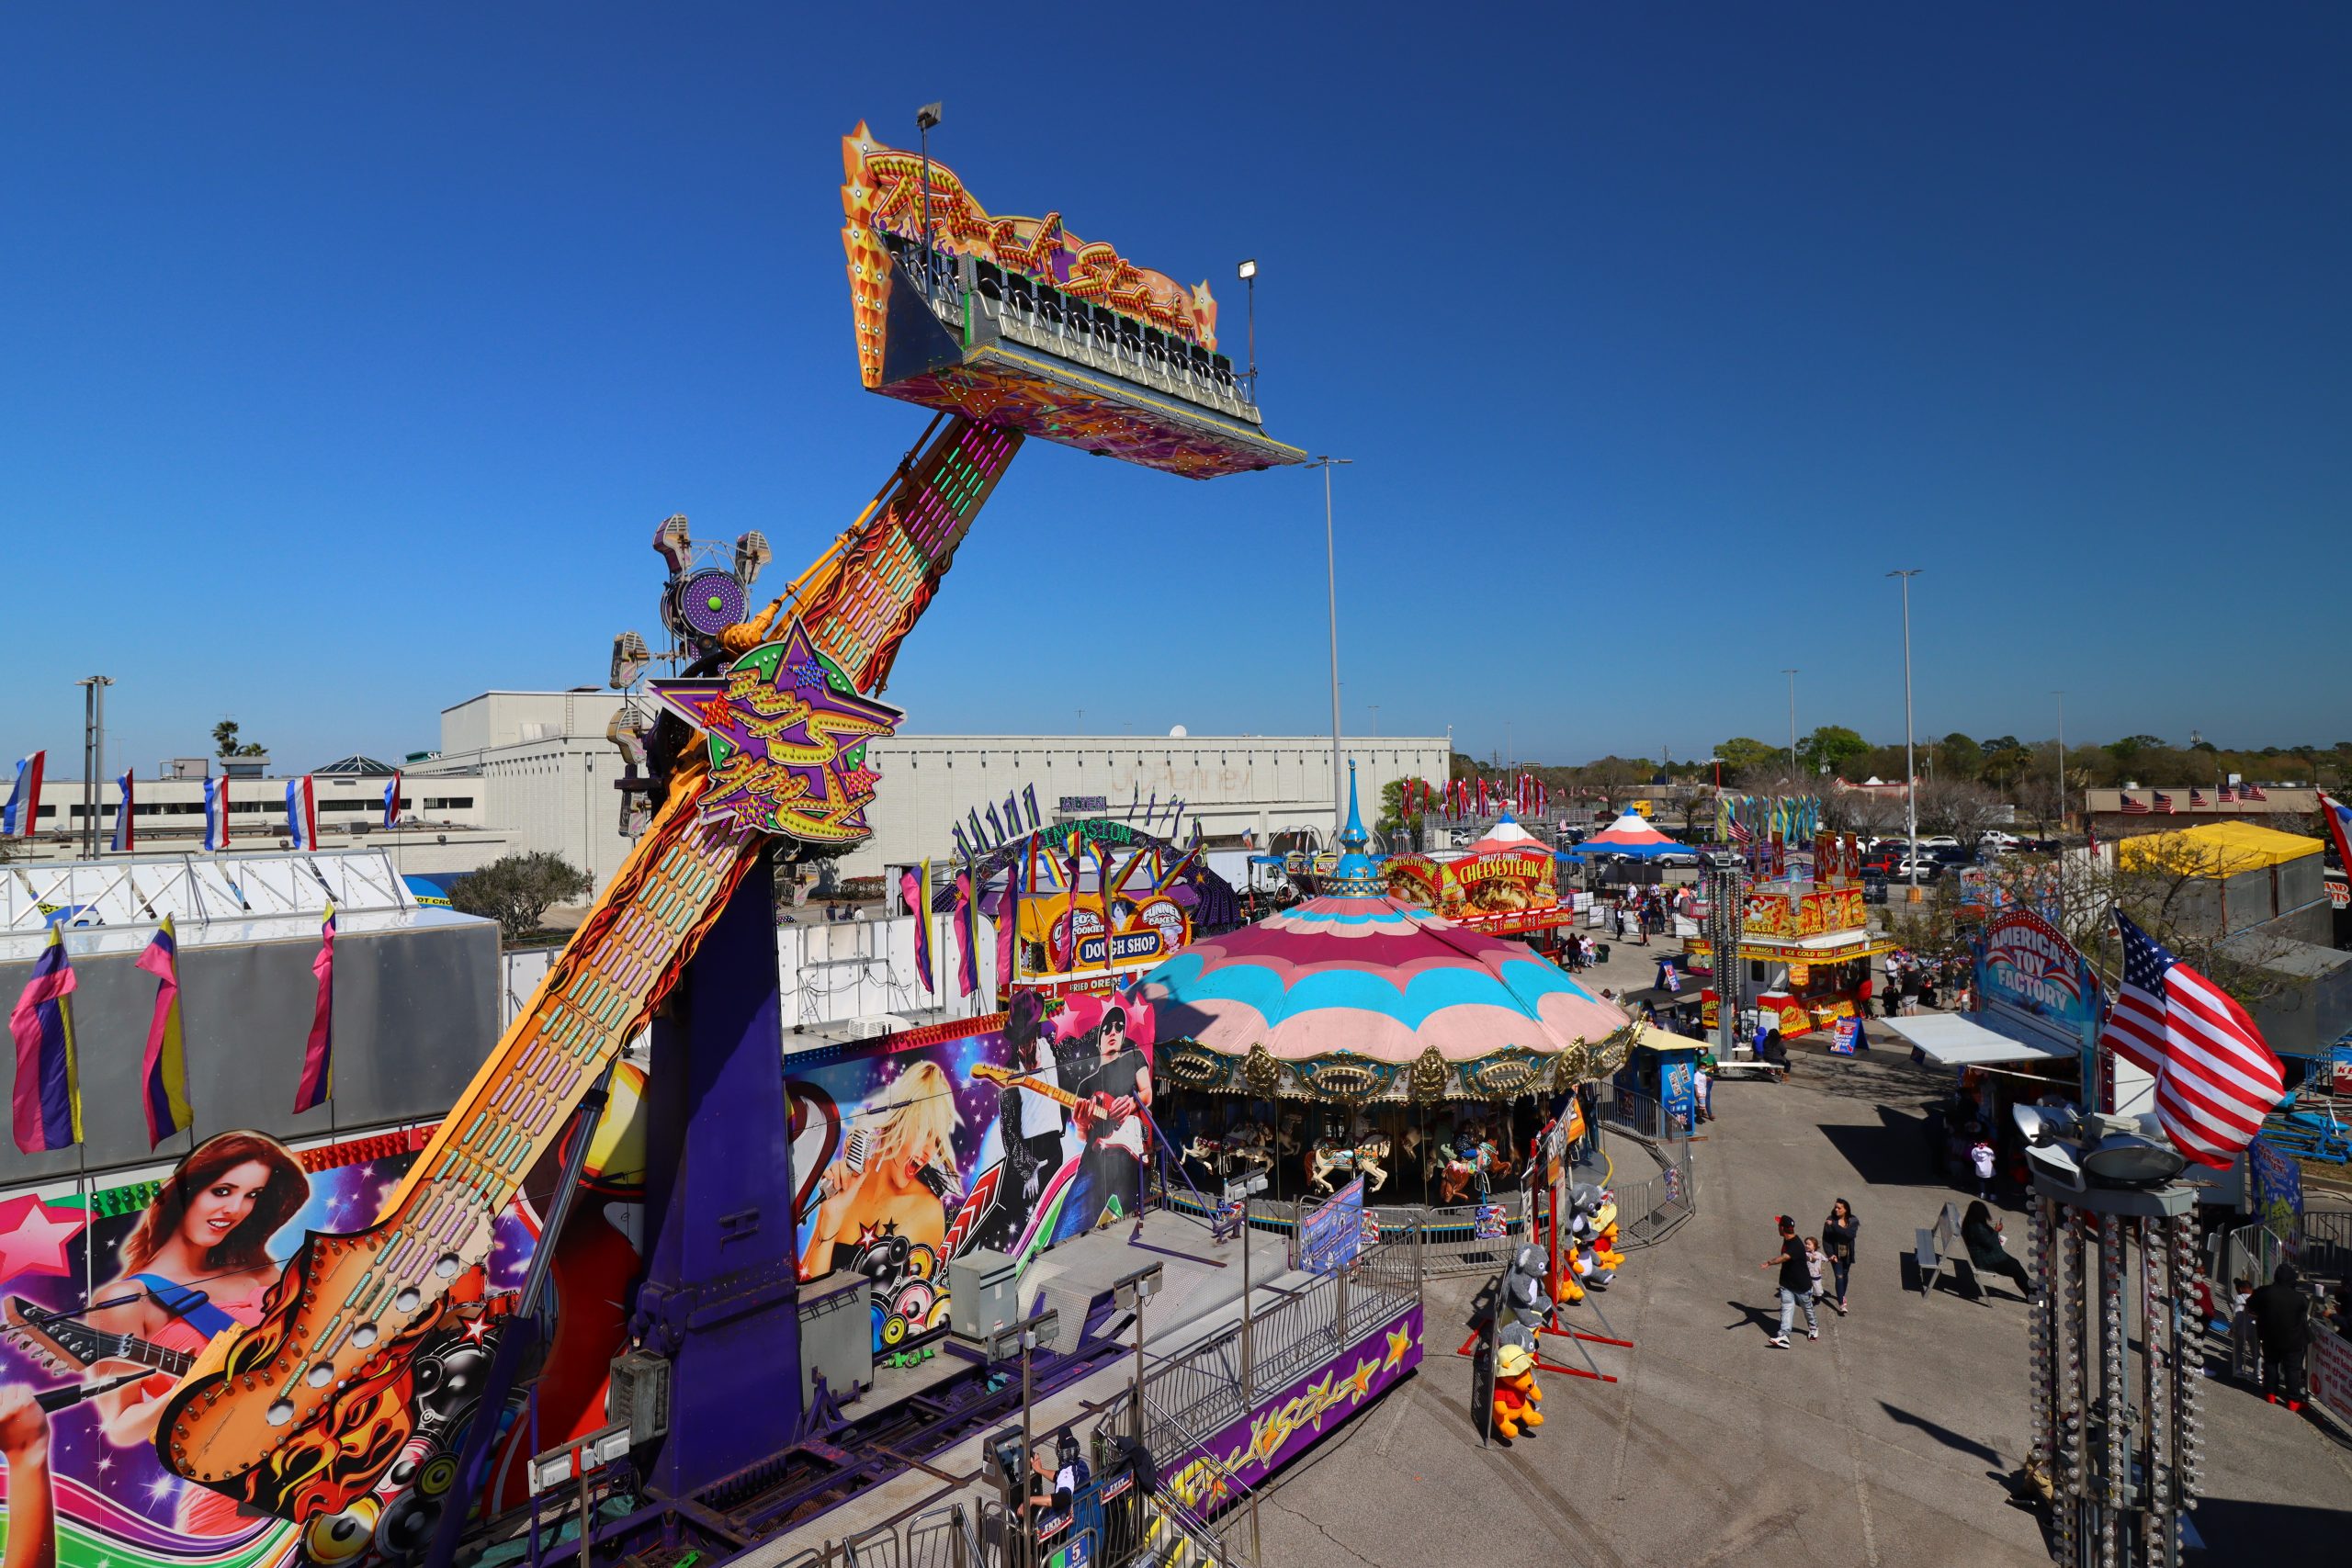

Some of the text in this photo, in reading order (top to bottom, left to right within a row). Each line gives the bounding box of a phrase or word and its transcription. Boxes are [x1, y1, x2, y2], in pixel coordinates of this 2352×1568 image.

[723, 668, 895, 764] Star
[697, 753, 876, 840] Rock
[1039, 820, 1133, 848] INVASION
[1478, 852, 1500, 863] PHILLY'S
[1459, 859, 1540, 885] CHEESESTEAK
[1142, 902, 1182, 923] FUNNEL
[1148, 915, 1175, 926] CAKES
[1053, 913, 1100, 942] OEO'S
[1127, 935, 1156, 953] SHOP
[1991, 926, 2077, 978] AMERICA'S
[2014, 950, 2046, 977] TOY
[1998, 967, 2067, 1011] FACTORY
[1072, 1542, 1081, 1562] 5
